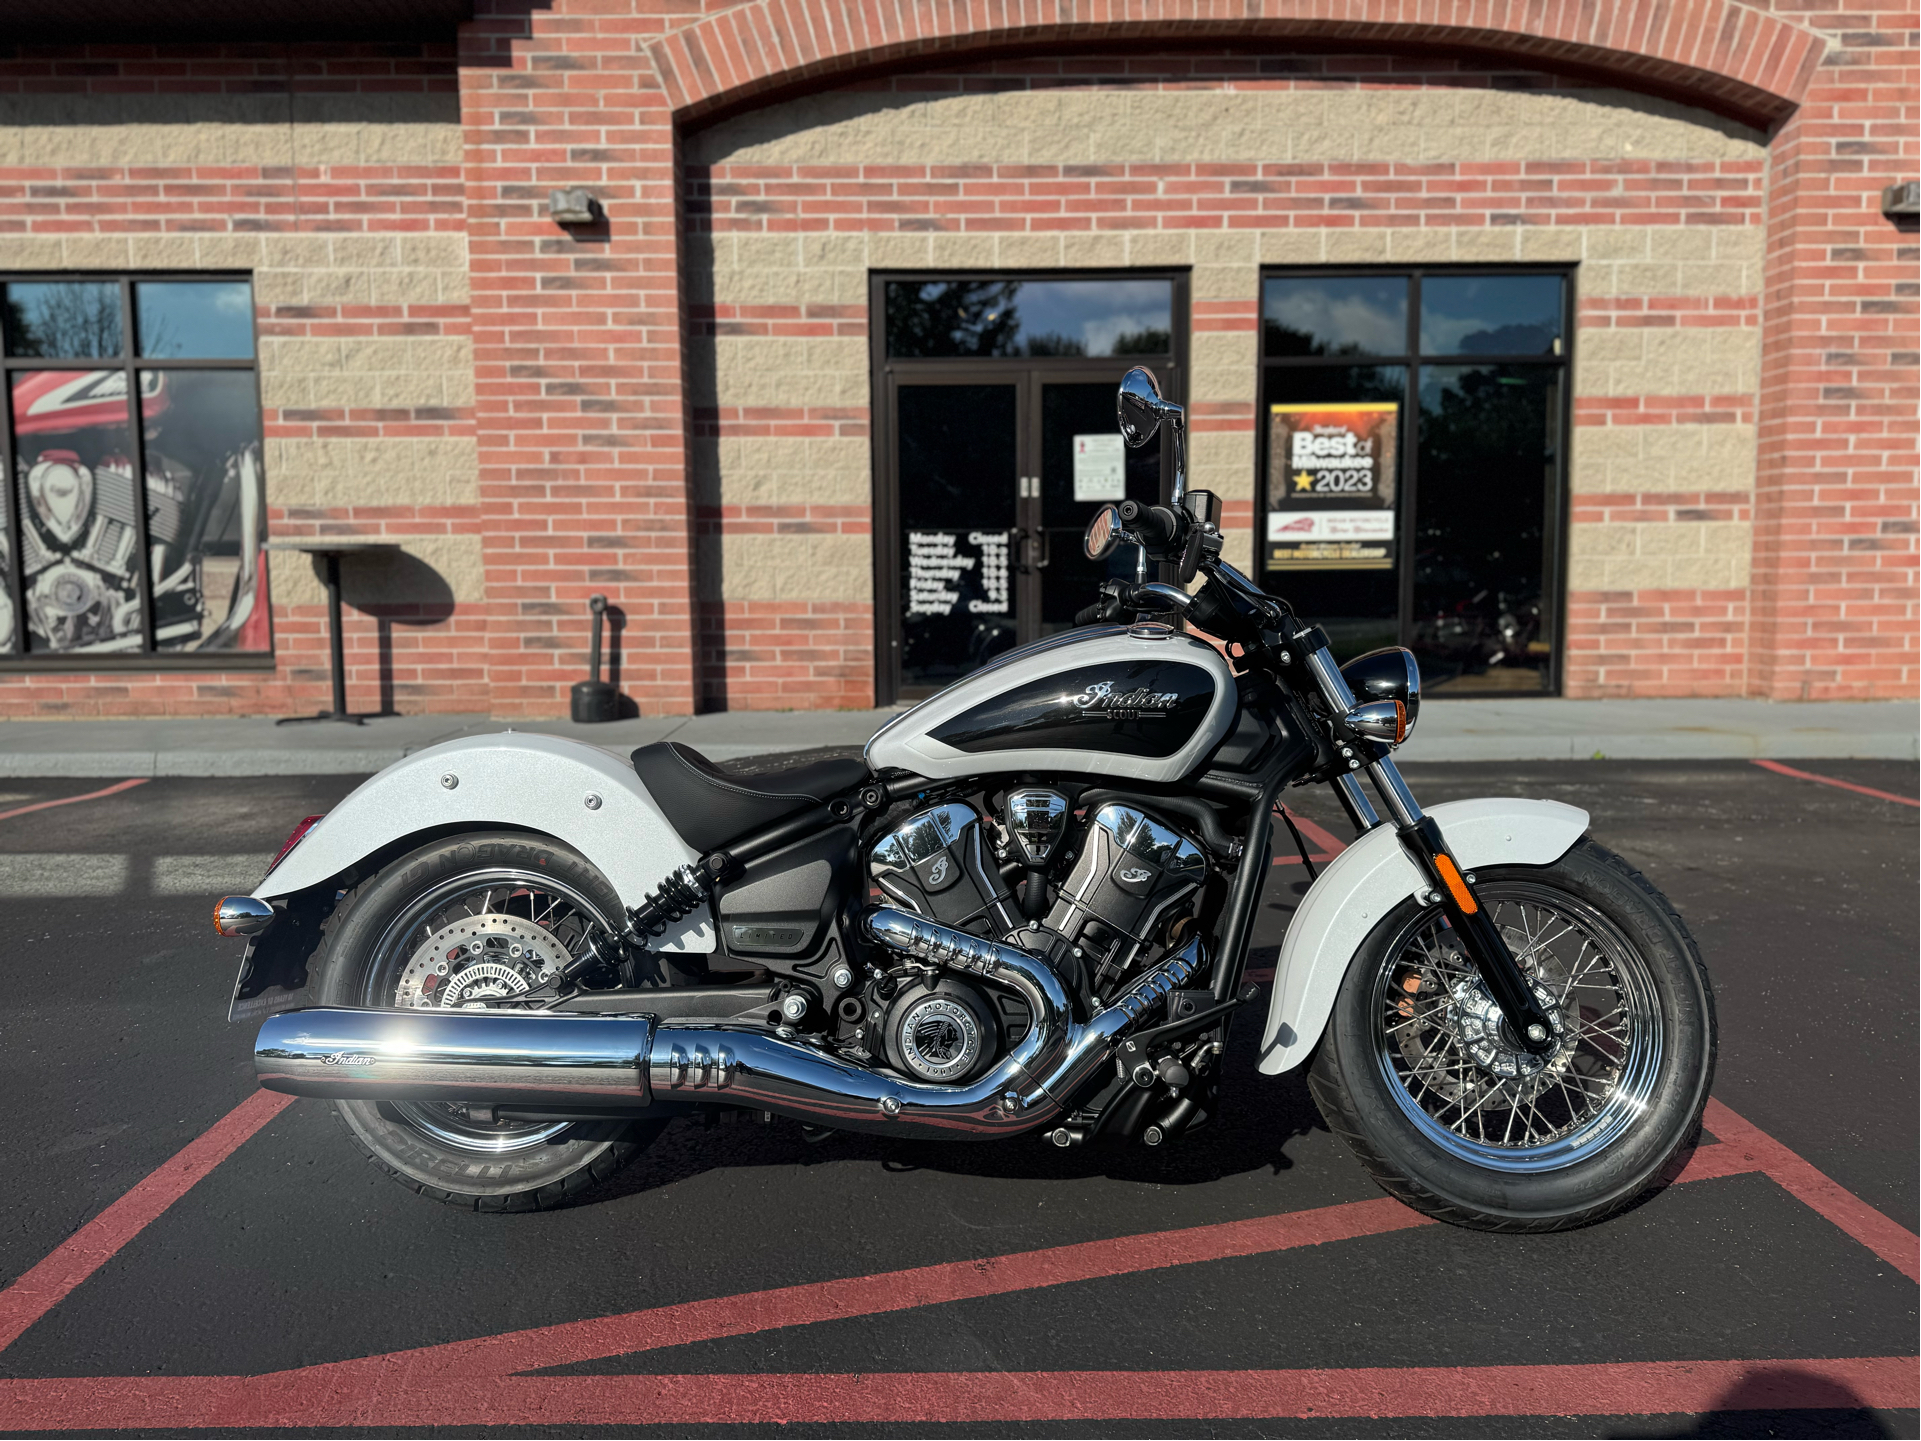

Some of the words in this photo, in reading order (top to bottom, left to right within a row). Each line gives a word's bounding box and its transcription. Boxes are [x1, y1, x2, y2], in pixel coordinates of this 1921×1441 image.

[1292, 431, 1358, 456] Best
[1356, 437, 1373, 456] of
[1292, 455, 1373, 470] Milwaukee
[1315, 470, 1373, 492] 2023
[909, 532, 956, 546] Monday
[968, 531, 1009, 545] Closed
[909, 544, 956, 558] Tuesday
[909, 554, 975, 570] Wednesday
[909, 566, 961, 582] Thursday
[909, 578, 945, 592] Friday
[909, 590, 960, 604] Saturday
[909, 601, 952, 616] Sunday
[968, 600, 1009, 613] Closed
[1073, 681, 1179, 709] Indian
[1106, 709, 1142, 720] SCOUT
[438, 842, 555, 871] DRAGON
[904, 1012, 921, 1061] INDIAN
[924, 1003, 976, 1063] MOTORCYCLE
[325, 1050, 371, 1066] Indian
[926, 1067, 953, 1076] 1901
[380, 1130, 514, 1182] PIRELLI
